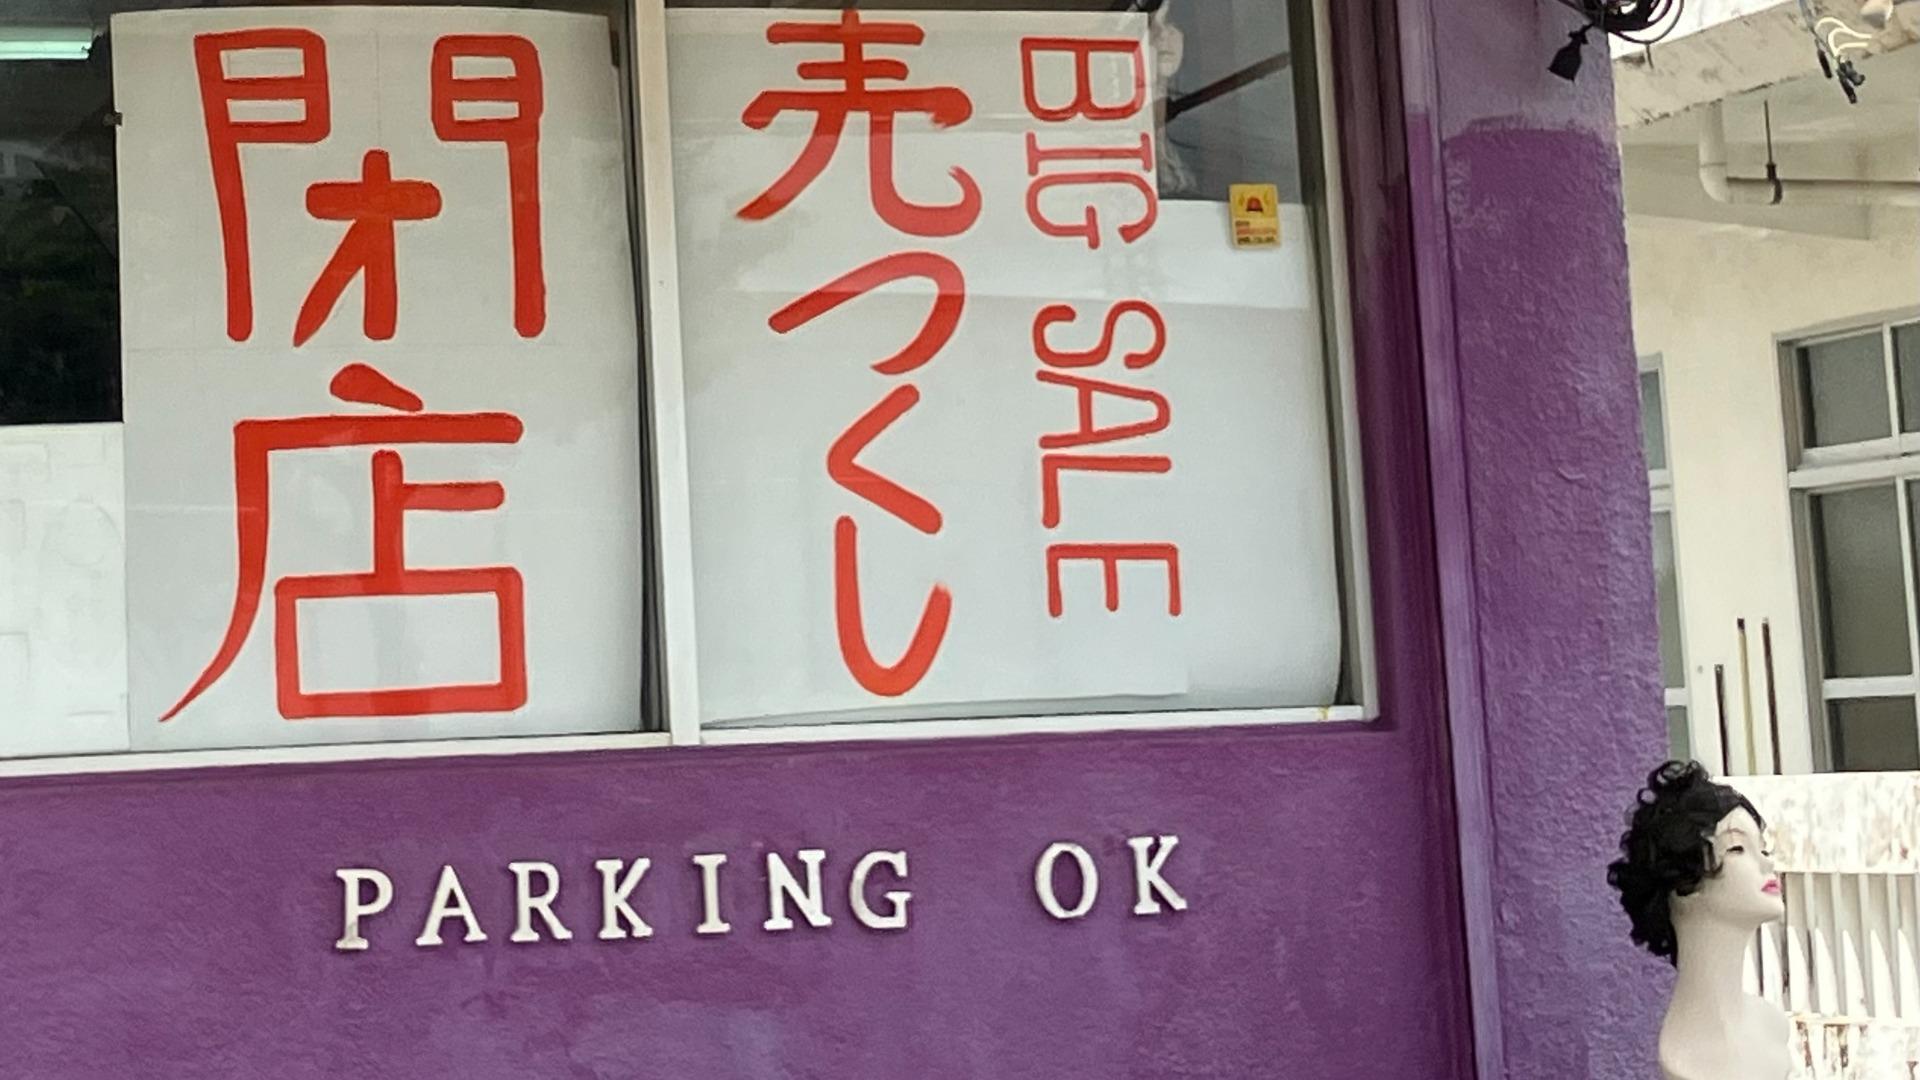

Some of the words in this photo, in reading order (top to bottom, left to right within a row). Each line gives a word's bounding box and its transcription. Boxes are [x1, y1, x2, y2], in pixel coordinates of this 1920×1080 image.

[1021, 36, 1158, 249] BIG
[162, 27, 545, 721] 閉店
[735, 9, 980, 697] 売つくし
[1031, 299, 1182, 618] SALE
[334, 848, 913, 952] PARKING
[1033, 834, 1188, 921] OK
